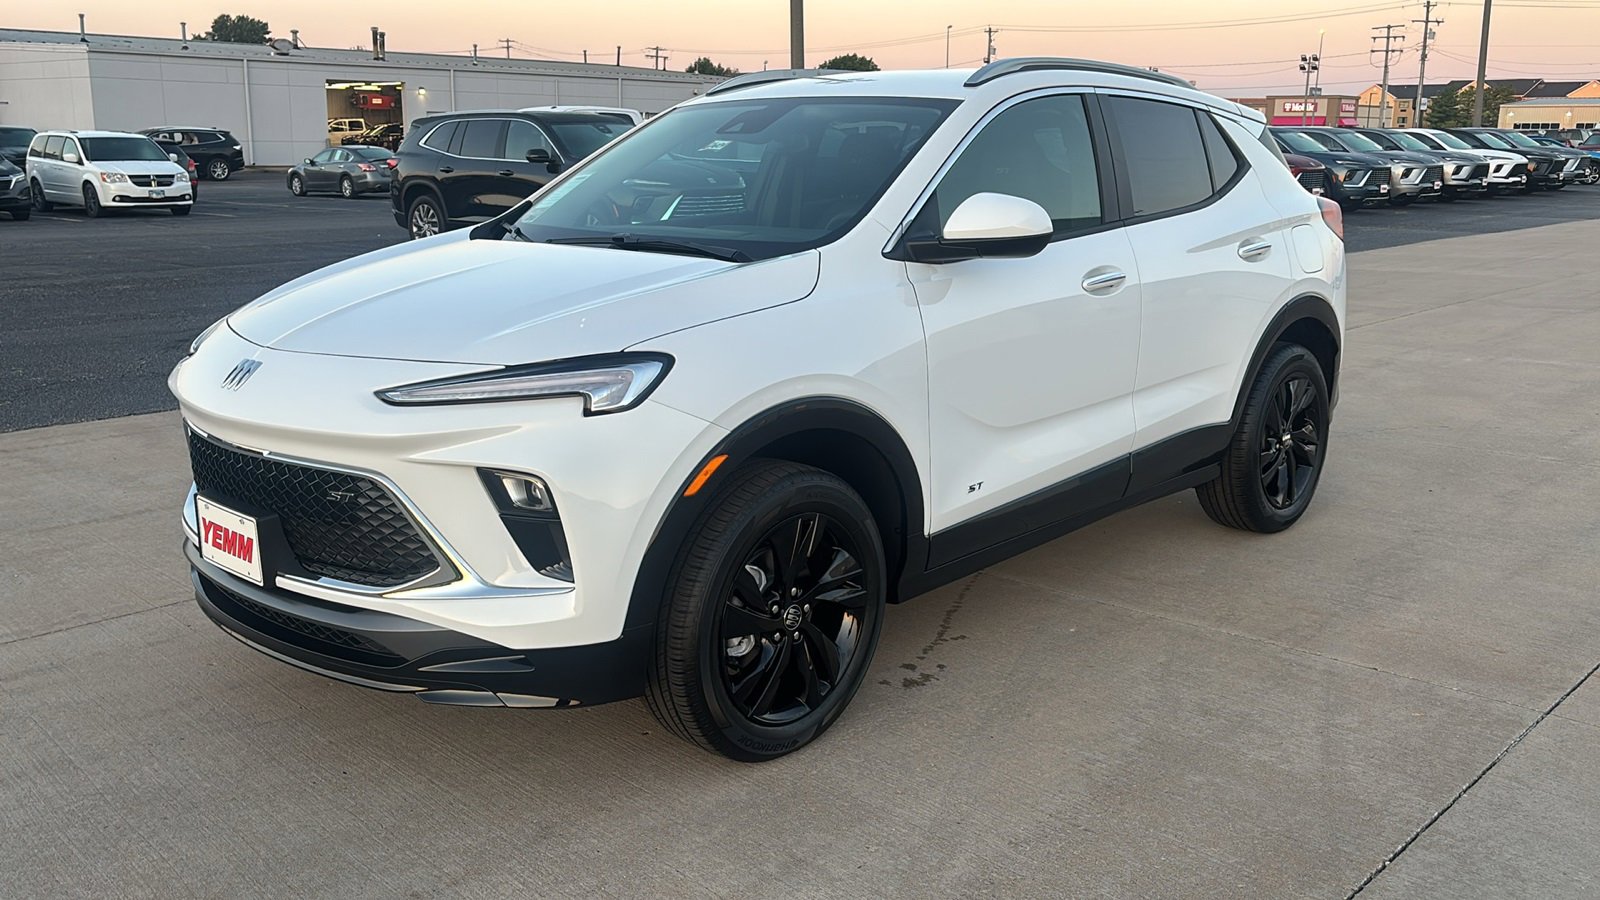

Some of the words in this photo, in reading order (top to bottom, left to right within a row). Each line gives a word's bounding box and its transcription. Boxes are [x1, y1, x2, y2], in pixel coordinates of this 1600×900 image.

[967, 481, 984, 494] ST
[326, 490, 354, 502] ST
[201, 516, 254, 564] YEMM
